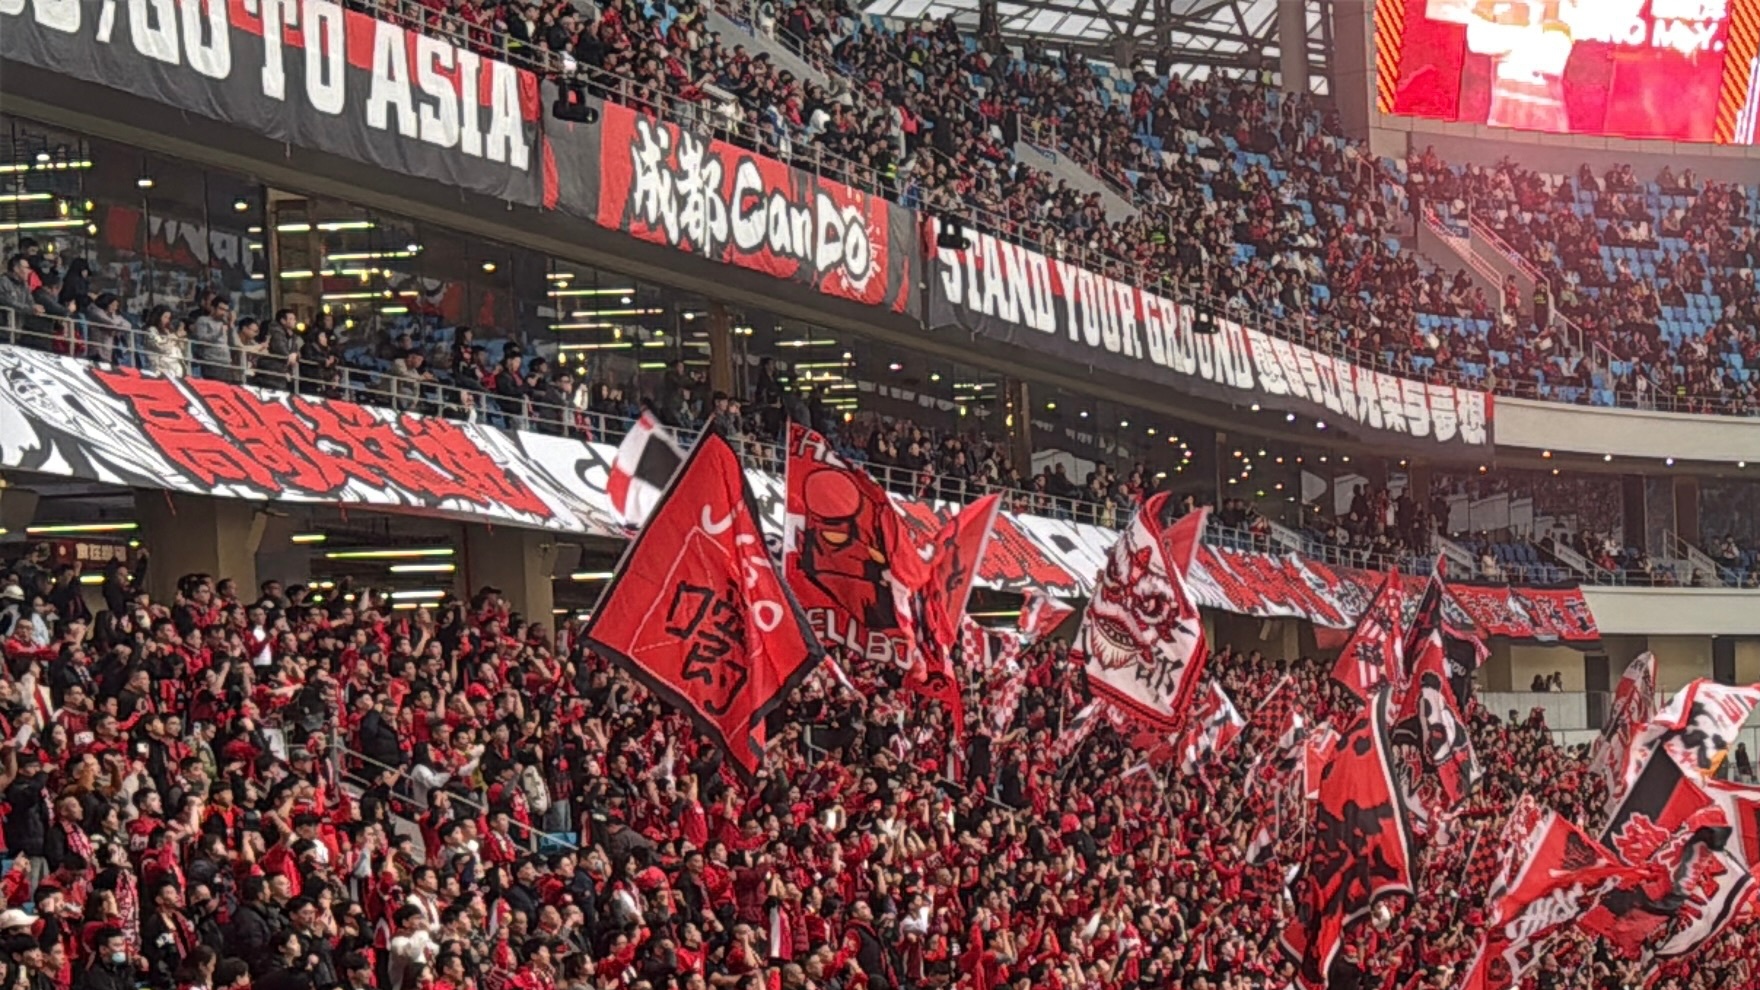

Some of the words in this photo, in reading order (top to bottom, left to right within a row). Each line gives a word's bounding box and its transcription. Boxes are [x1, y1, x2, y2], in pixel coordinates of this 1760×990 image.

[246, 0, 346, 116] TO
[367, 18, 530, 171] ASIA
[631, 120, 728, 258] 成都
[933, 217, 1057, 334] STAND
[1054, 257, 1143, 360] YOUR
[1138, 288, 1255, 389] GROUND
